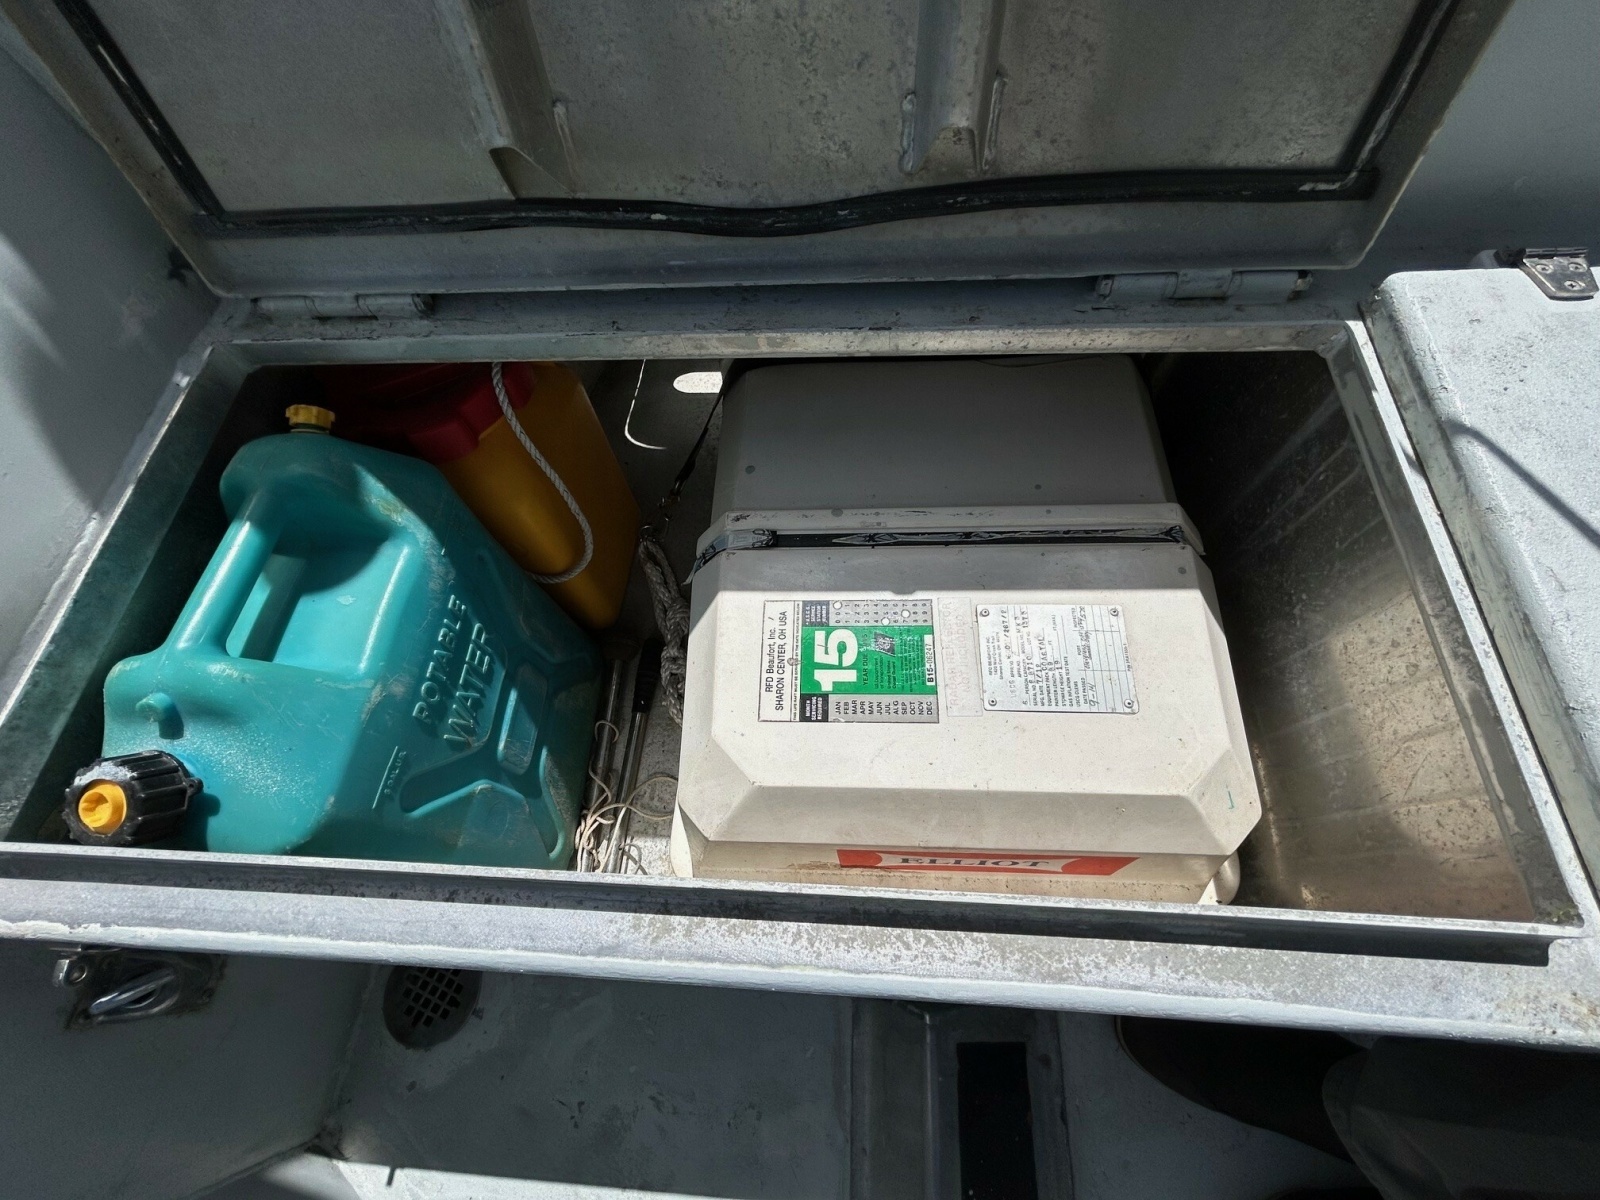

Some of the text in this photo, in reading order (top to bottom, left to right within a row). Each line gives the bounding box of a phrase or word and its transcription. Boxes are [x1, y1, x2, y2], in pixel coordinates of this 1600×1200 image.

[779, 629, 786, 640] OH
[412, 594, 467, 724] POTABLE
[766, 642, 775, 673] Beaufort,
[777, 643, 787, 675] CENTER,
[814, 629, 858, 691] 15
[956, 614, 970, 693] NOT INCLUDED
[1038, 637, 1047, 671] COASTAL
[444, 622, 493, 744] WATER
[765, 677, 773, 692] RFD
[775, 678, 784, 710] SHARON
[949, 667, 959, 705] RADAR
[900, 857, 1050, 867] ELLIOT
